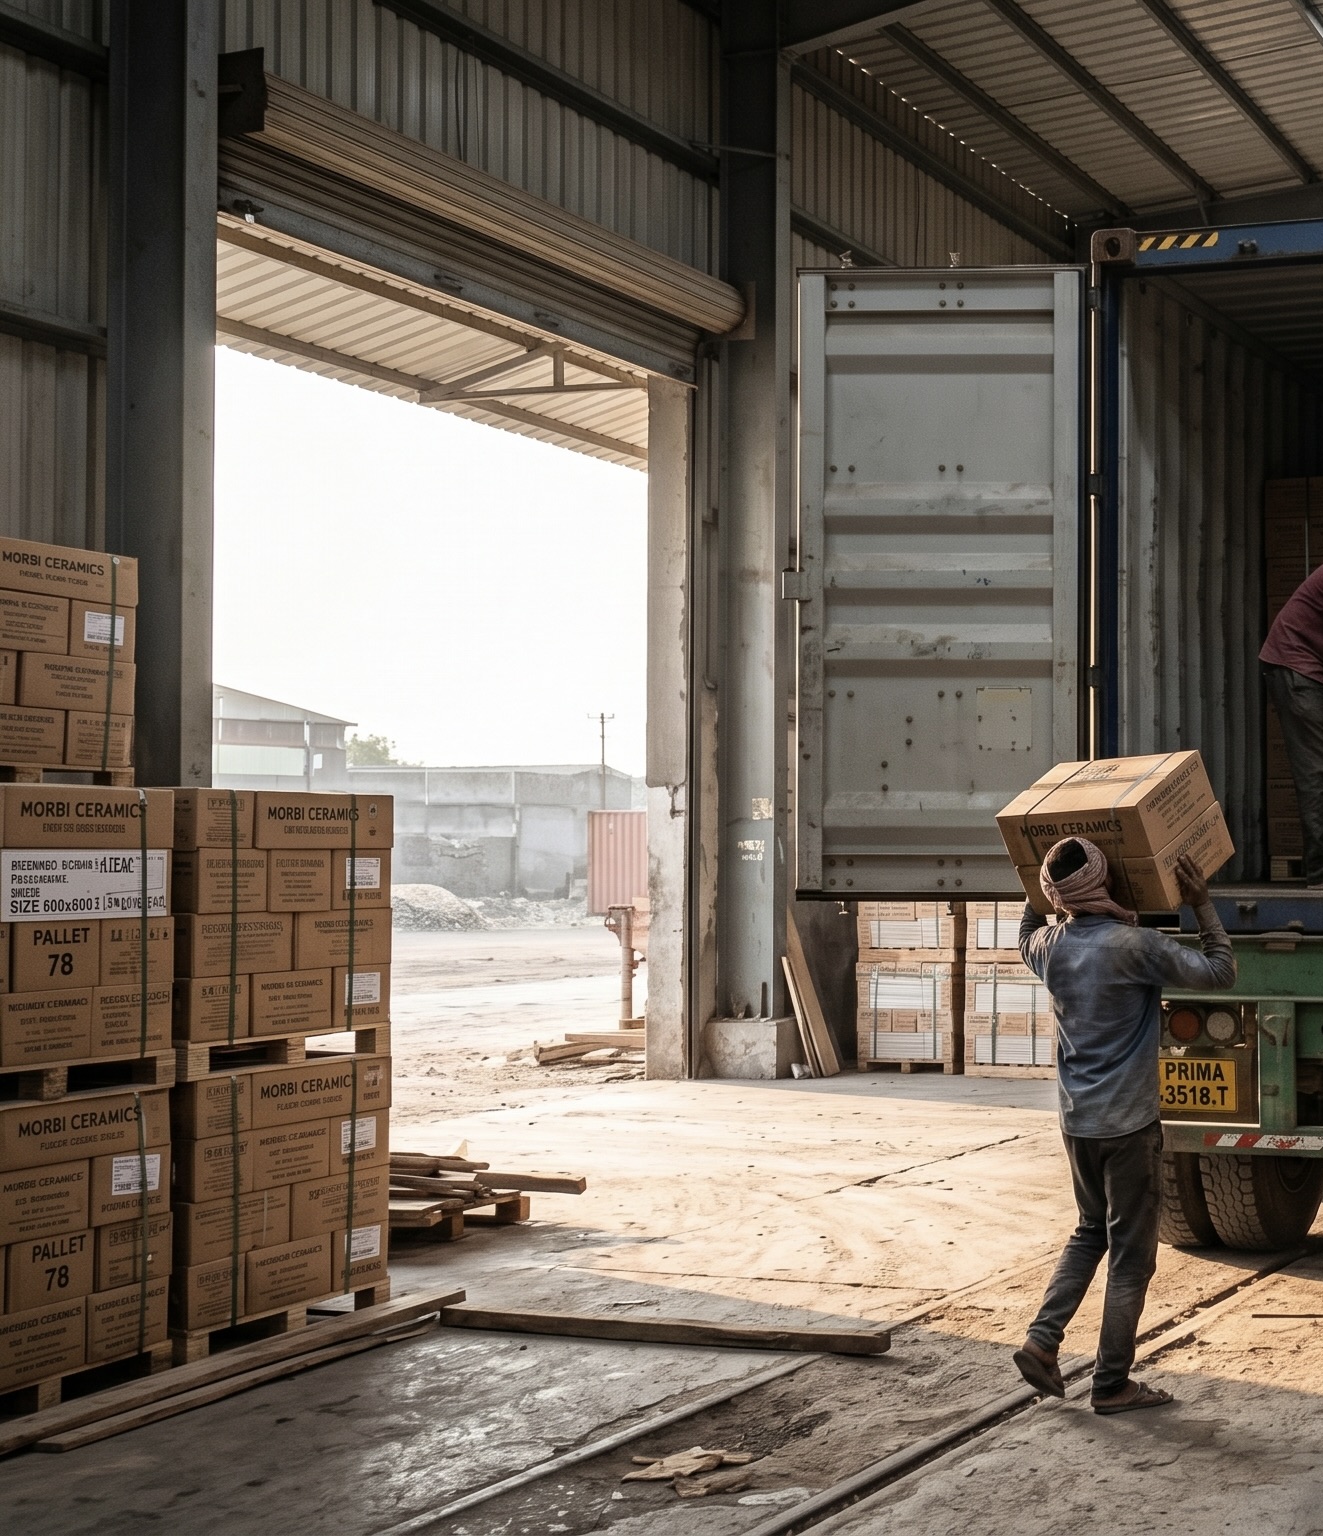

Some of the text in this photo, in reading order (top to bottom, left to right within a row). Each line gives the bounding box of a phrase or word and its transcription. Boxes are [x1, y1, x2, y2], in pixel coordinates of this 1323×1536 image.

[45, 557, 105, 576] CERAMICS
[20, 801, 70, 818] MORBI
[267, 806, 359, 821] MORBI CERAMICS
[1061, 819, 1122, 835] CERAMICS
[10, 900, 40, 913] SIZE
[33, 927, 90, 946] PALLET
[48, 953, 73, 976] 78
[1165, 1062, 1225, 1081] PRIMA
[260, 1074, 353, 1099] MORBI CERAMIC
[18, 1116, 66, 1137] MORBI
[32, 1234, 86, 1263] PALLET
[45, 1265, 69, 1291] 78
